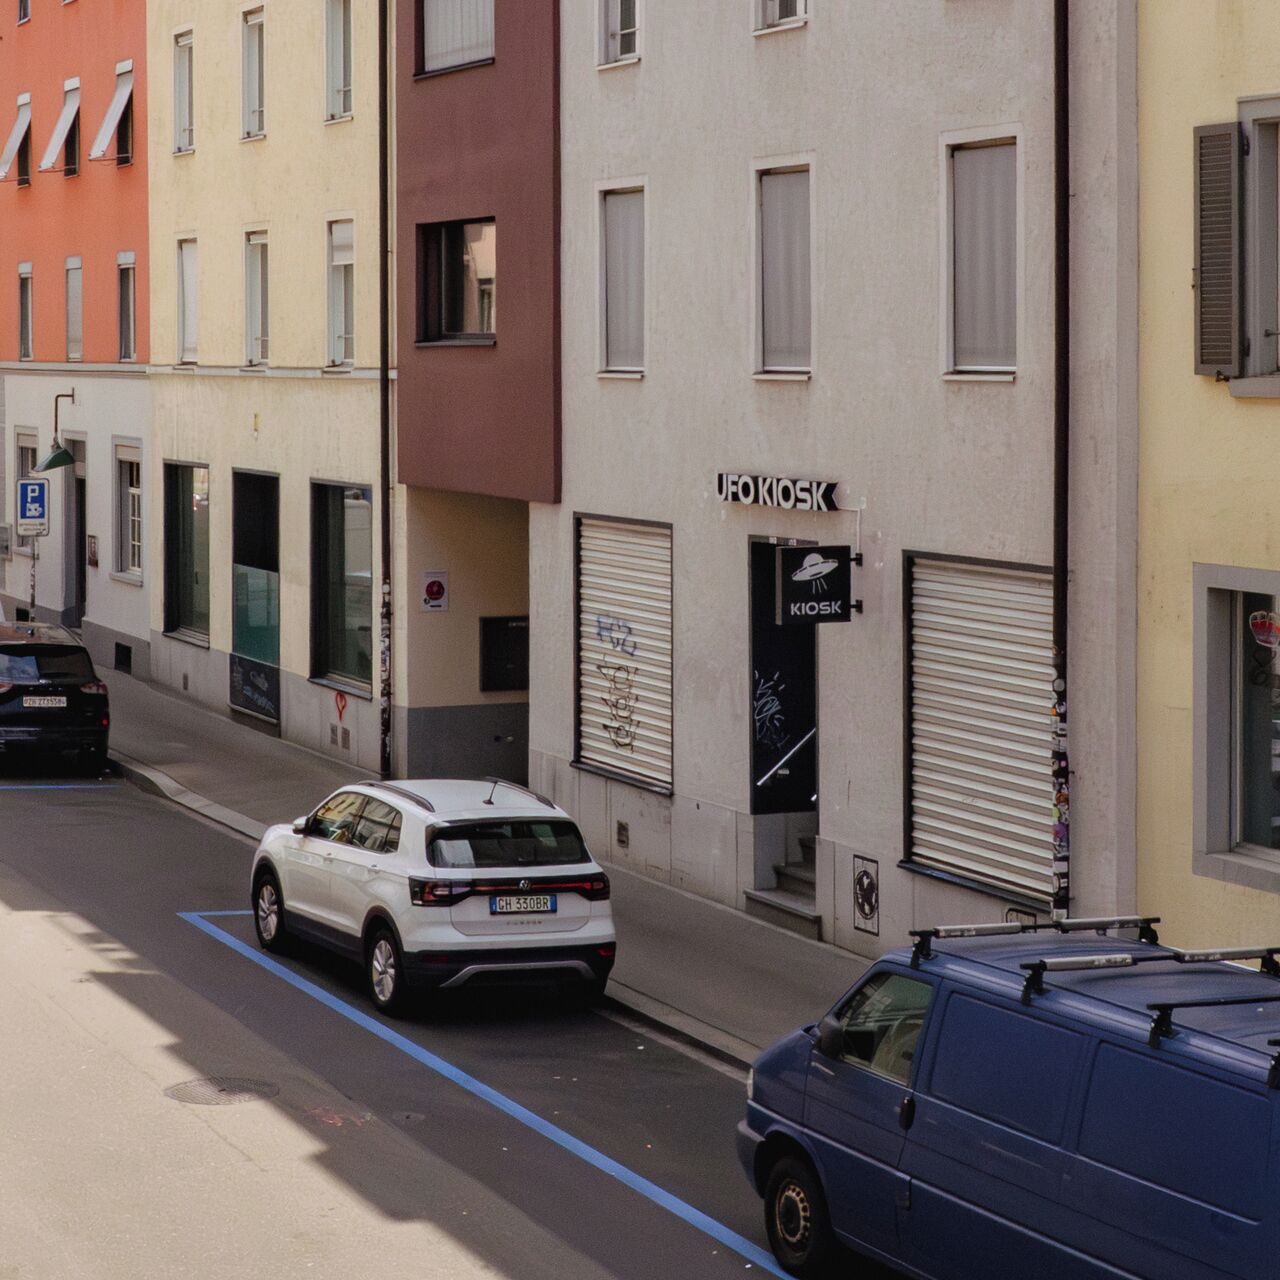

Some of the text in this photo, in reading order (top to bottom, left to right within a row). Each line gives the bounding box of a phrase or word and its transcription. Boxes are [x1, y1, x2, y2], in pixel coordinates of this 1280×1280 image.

[27, 485, 39, 503] P
[717, 473, 829, 512] UFO KIOSK
[790, 600, 842, 616] KIOSK
